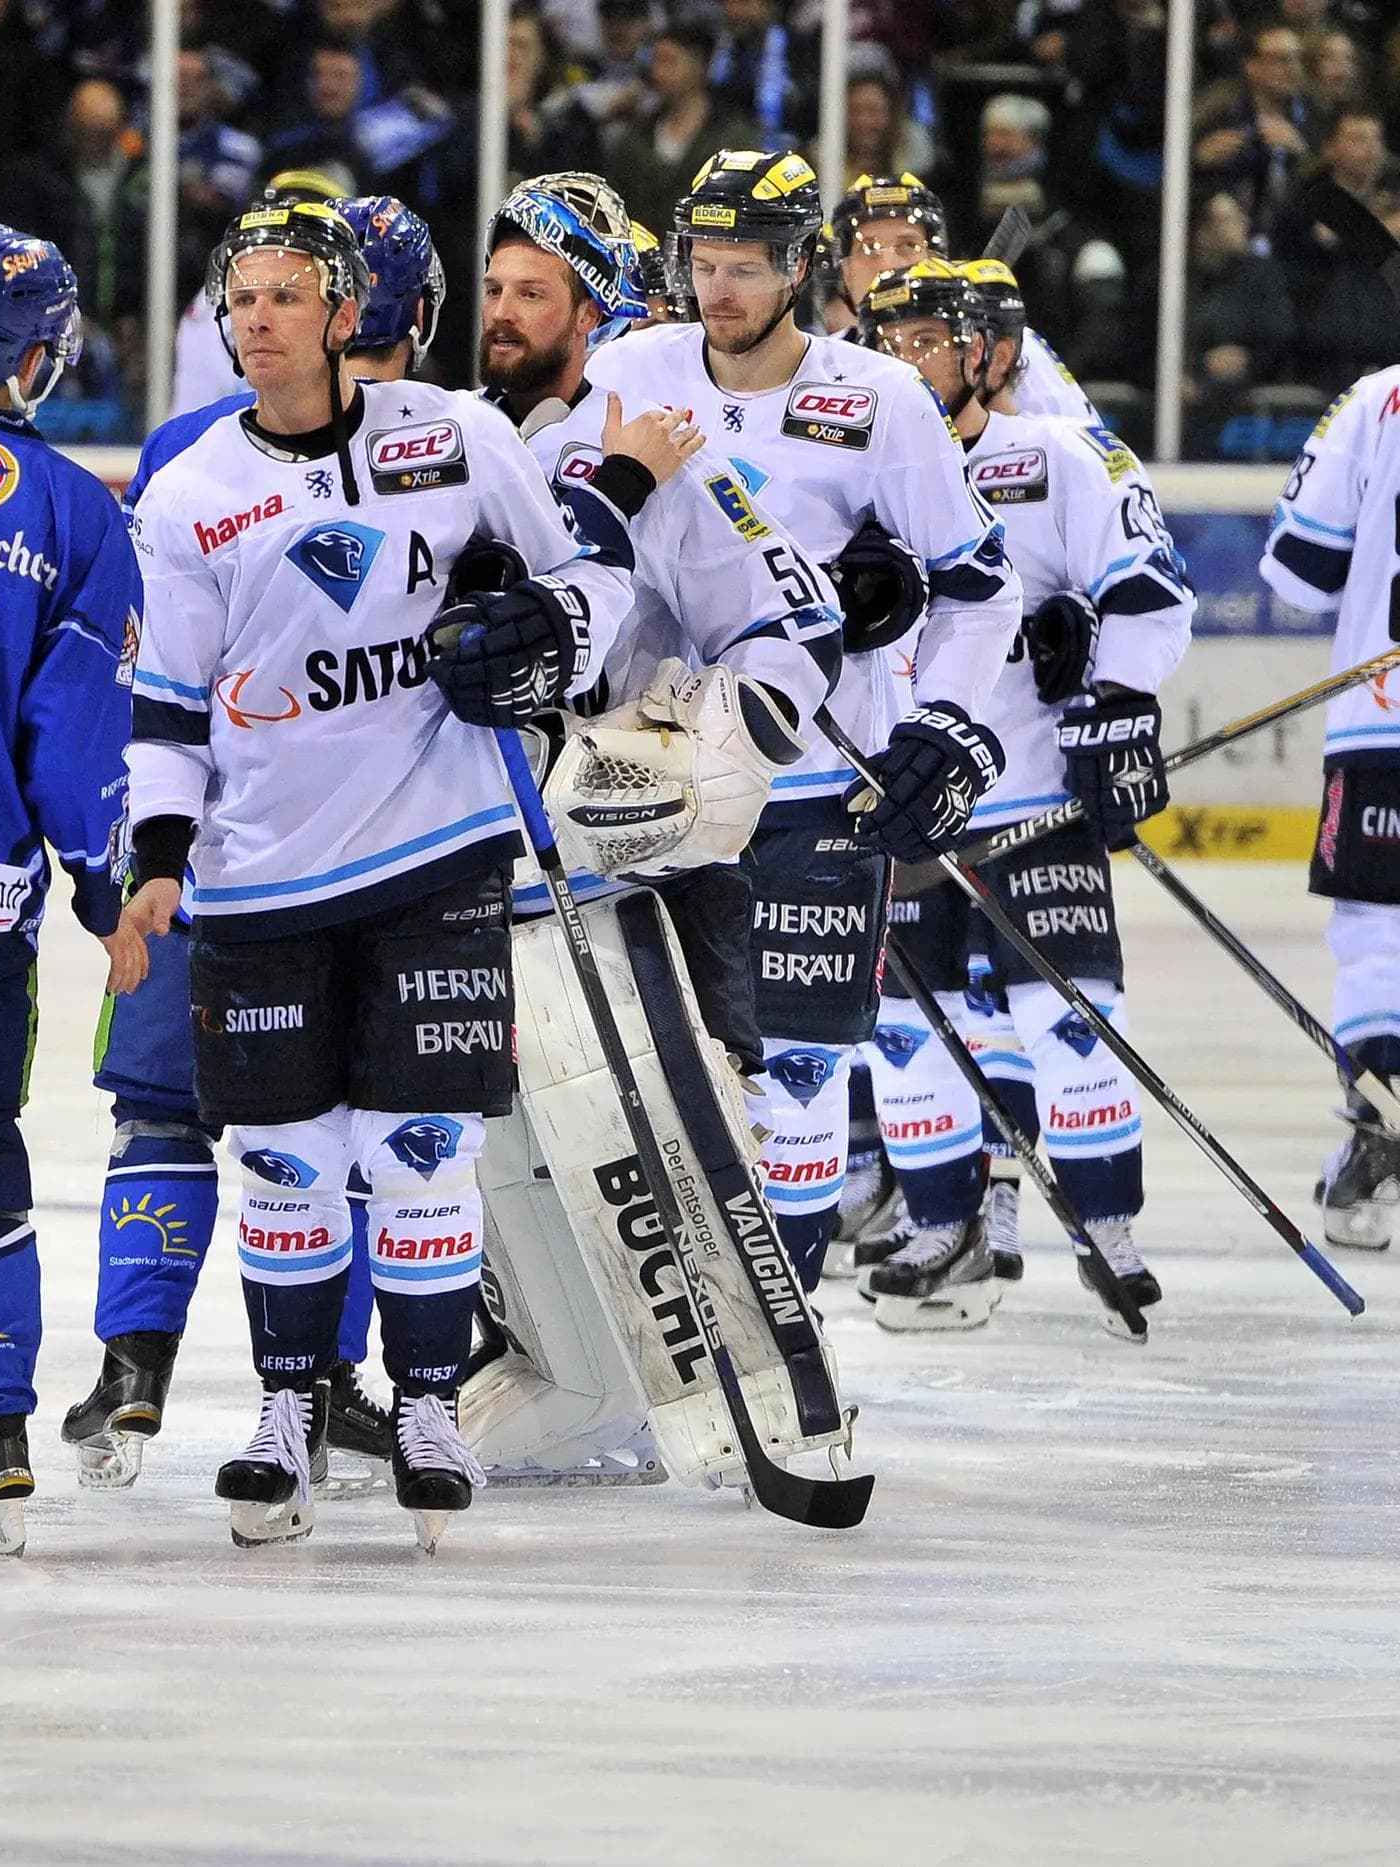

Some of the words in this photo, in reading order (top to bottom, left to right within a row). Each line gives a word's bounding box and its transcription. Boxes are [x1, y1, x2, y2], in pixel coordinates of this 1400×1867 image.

[795, 393, 870, 419] DEL
[378, 427, 452, 464] DEL
[976, 453, 1039, 482] DEL
[193, 494, 286, 556] hama
[406, 529, 438, 595] A
[529, 574, 590, 681] BAUE
[305, 634, 433, 713] SATU
[900, 707, 1001, 790] BAUER
[1054, 714, 1156, 749] AUER
[585, 807, 657, 823] VISION
[988, 797, 1086, 854] SUPRE
[1008, 862, 1106, 900] HERRN
[555, 880, 590, 956] BAUER
[753, 900, 866, 937] HERRN
[1026, 903, 1108, 938] BRÄU
[397, 966, 508, 1004] HERRN
[761, 950, 855, 986] BRÄU
[225, 1004, 304, 1034] SATURN
[415, 1019, 503, 1056] BRÄU
[1049, 1099, 1133, 1131] hama
[773, 1130, 833, 1146] BAUER
[248, 1197, 311, 1213] BAUER
[394, 1204, 462, 1220] BAUER
[662, 1138, 686, 1174] Der
[677, 1175, 721, 1259] Entsorger
[238, 1212, 332, 1252] hama
[377, 1227, 475, 1260] hama
[724, 1190, 805, 1326] VAUGHN
[672, 1226, 725, 1351] NEXUS
